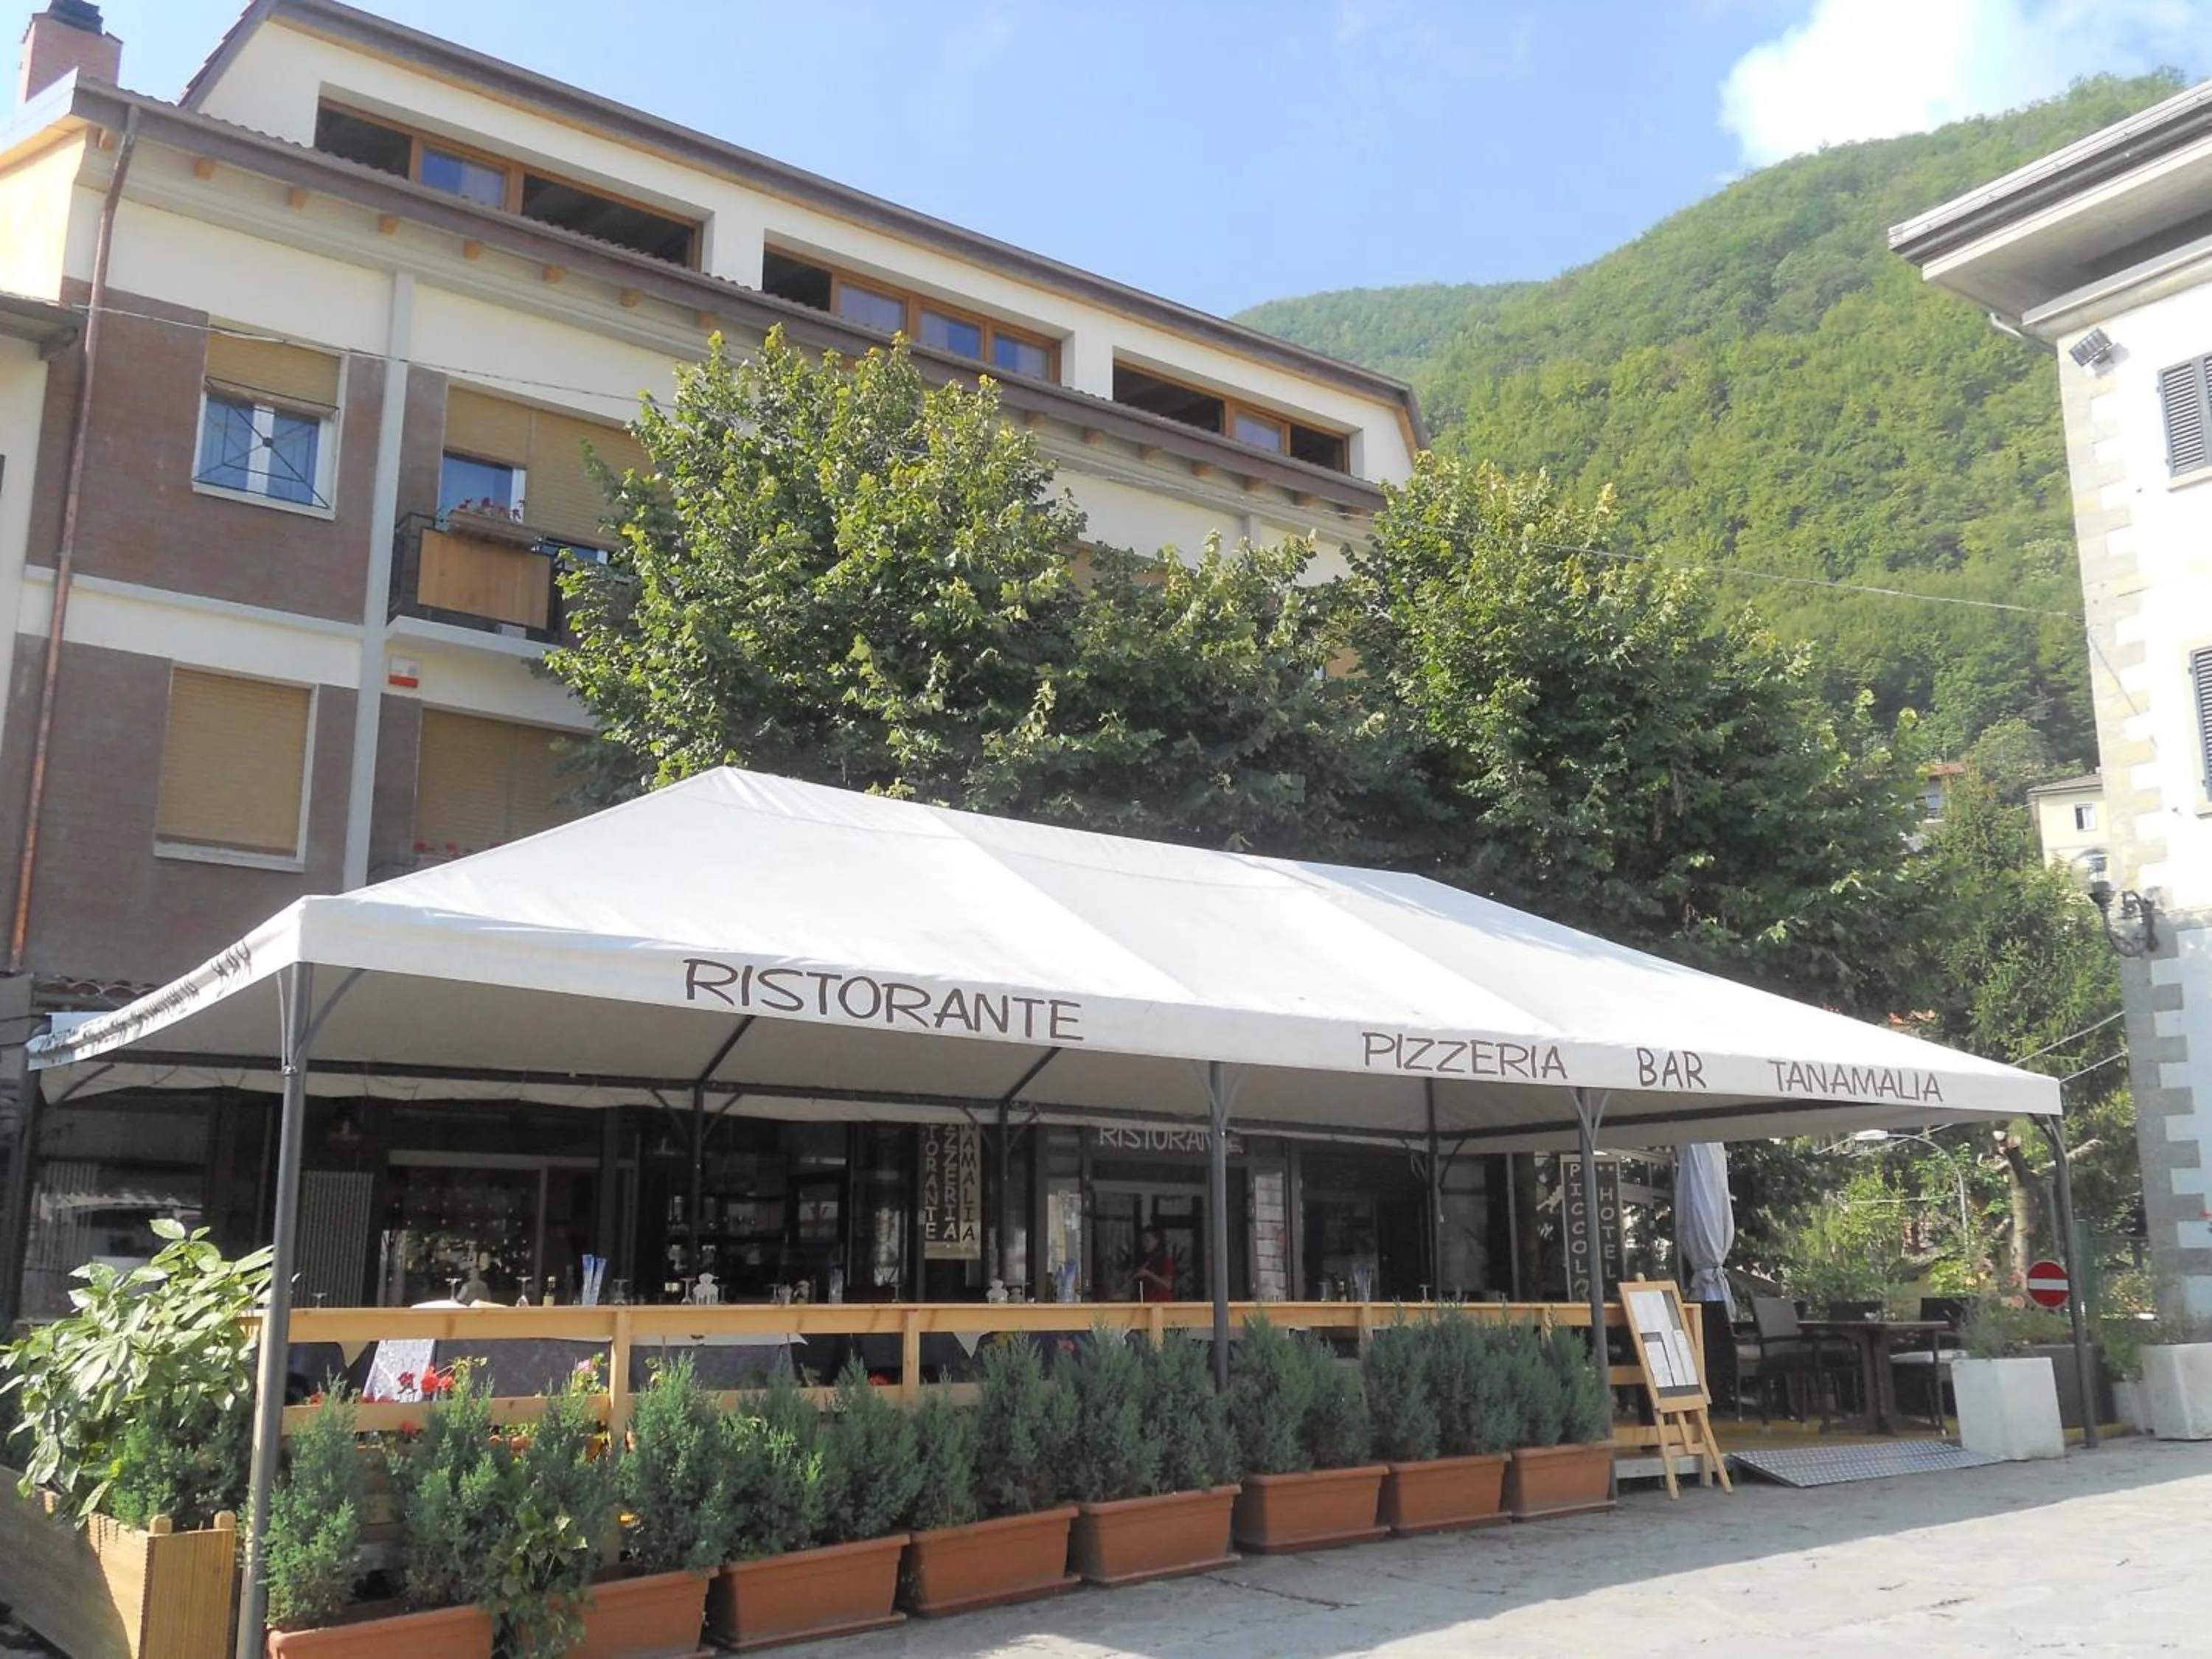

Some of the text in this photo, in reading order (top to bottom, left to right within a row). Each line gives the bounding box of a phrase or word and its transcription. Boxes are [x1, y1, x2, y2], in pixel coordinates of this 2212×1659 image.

[683, 957, 1944, 1103] RISTORANTE PIZZERIA BAR TANAMALIA
[925, 1124, 939, 1240] TORANTE
[942, 1124, 958, 1240] ZZERIA
[960, 1124, 978, 1242] AMALIA
[1599, 1186, 1617, 1279] HOTEL
